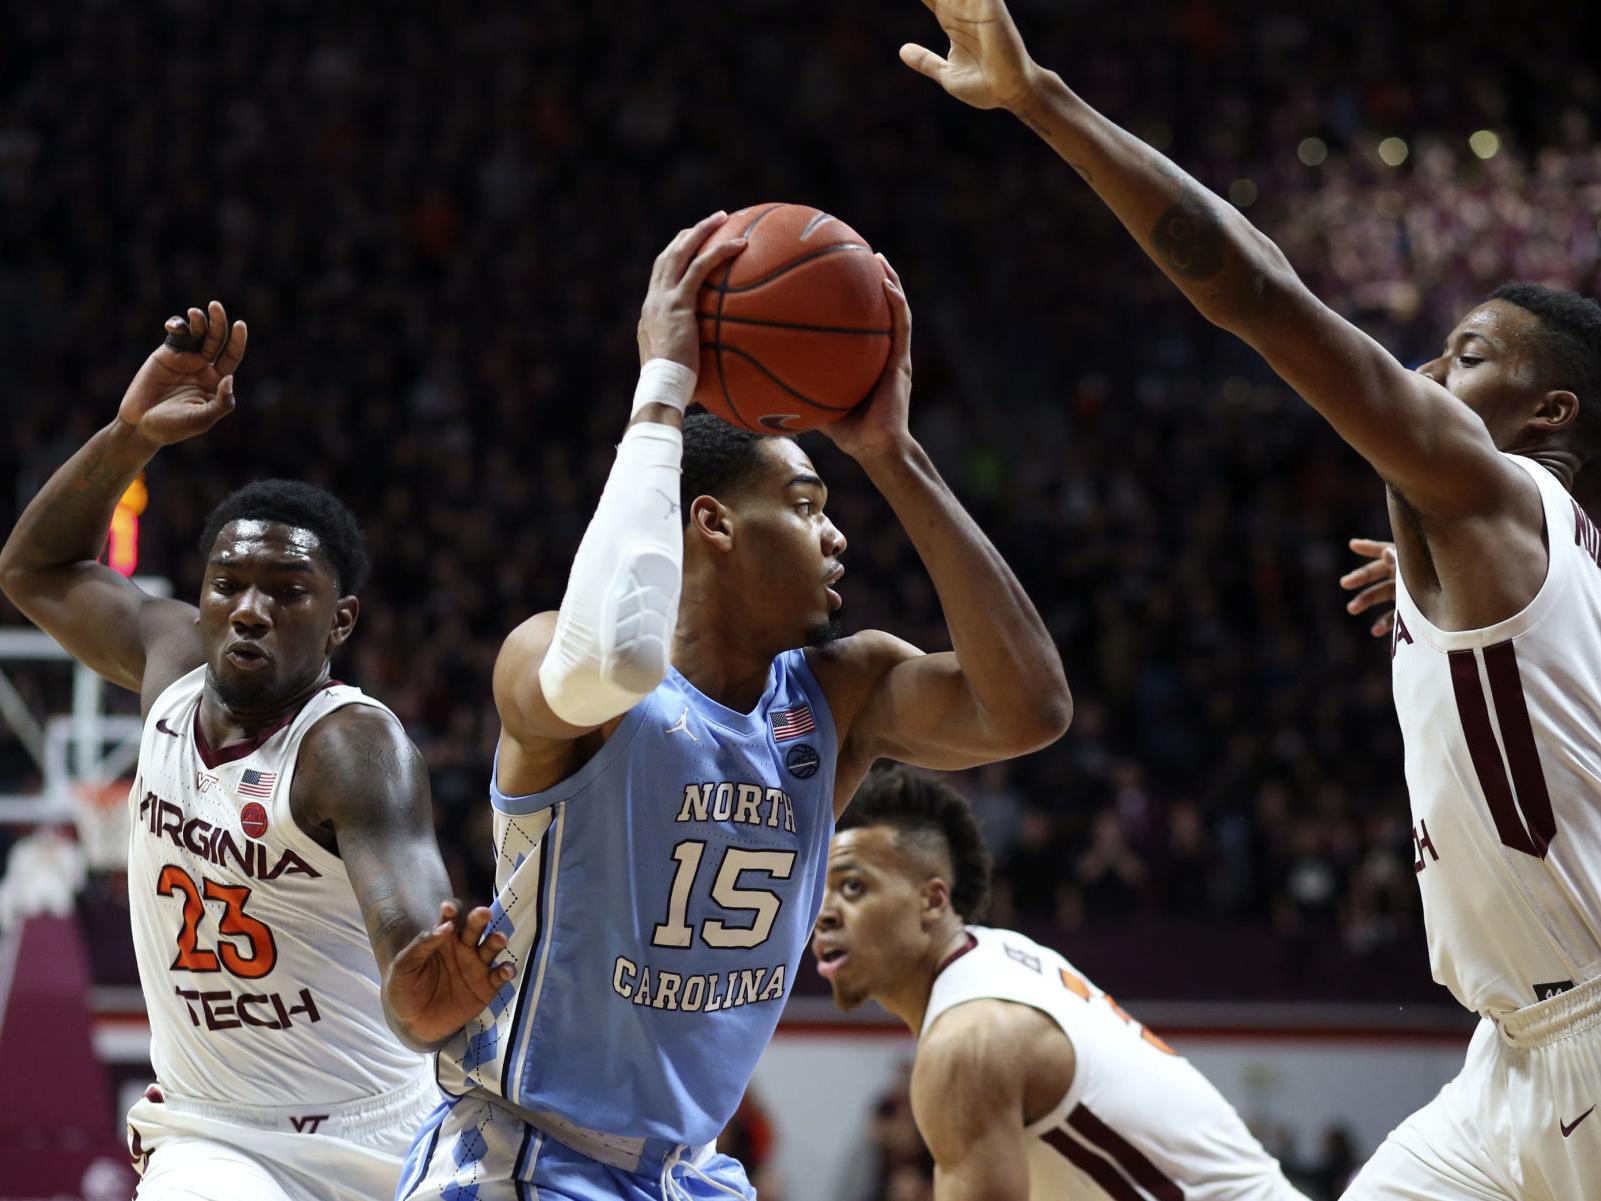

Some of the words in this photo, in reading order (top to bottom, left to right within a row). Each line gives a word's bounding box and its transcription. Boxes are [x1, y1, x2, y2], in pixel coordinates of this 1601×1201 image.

[676, 781, 797, 834] NORTH
[157, 864, 278, 979] 23
[651, 839, 798, 949] 15
[175, 986, 321, 1031] TECH
[612, 955, 786, 1013] CAROLINA
[290, 1115, 329, 1133] VT
